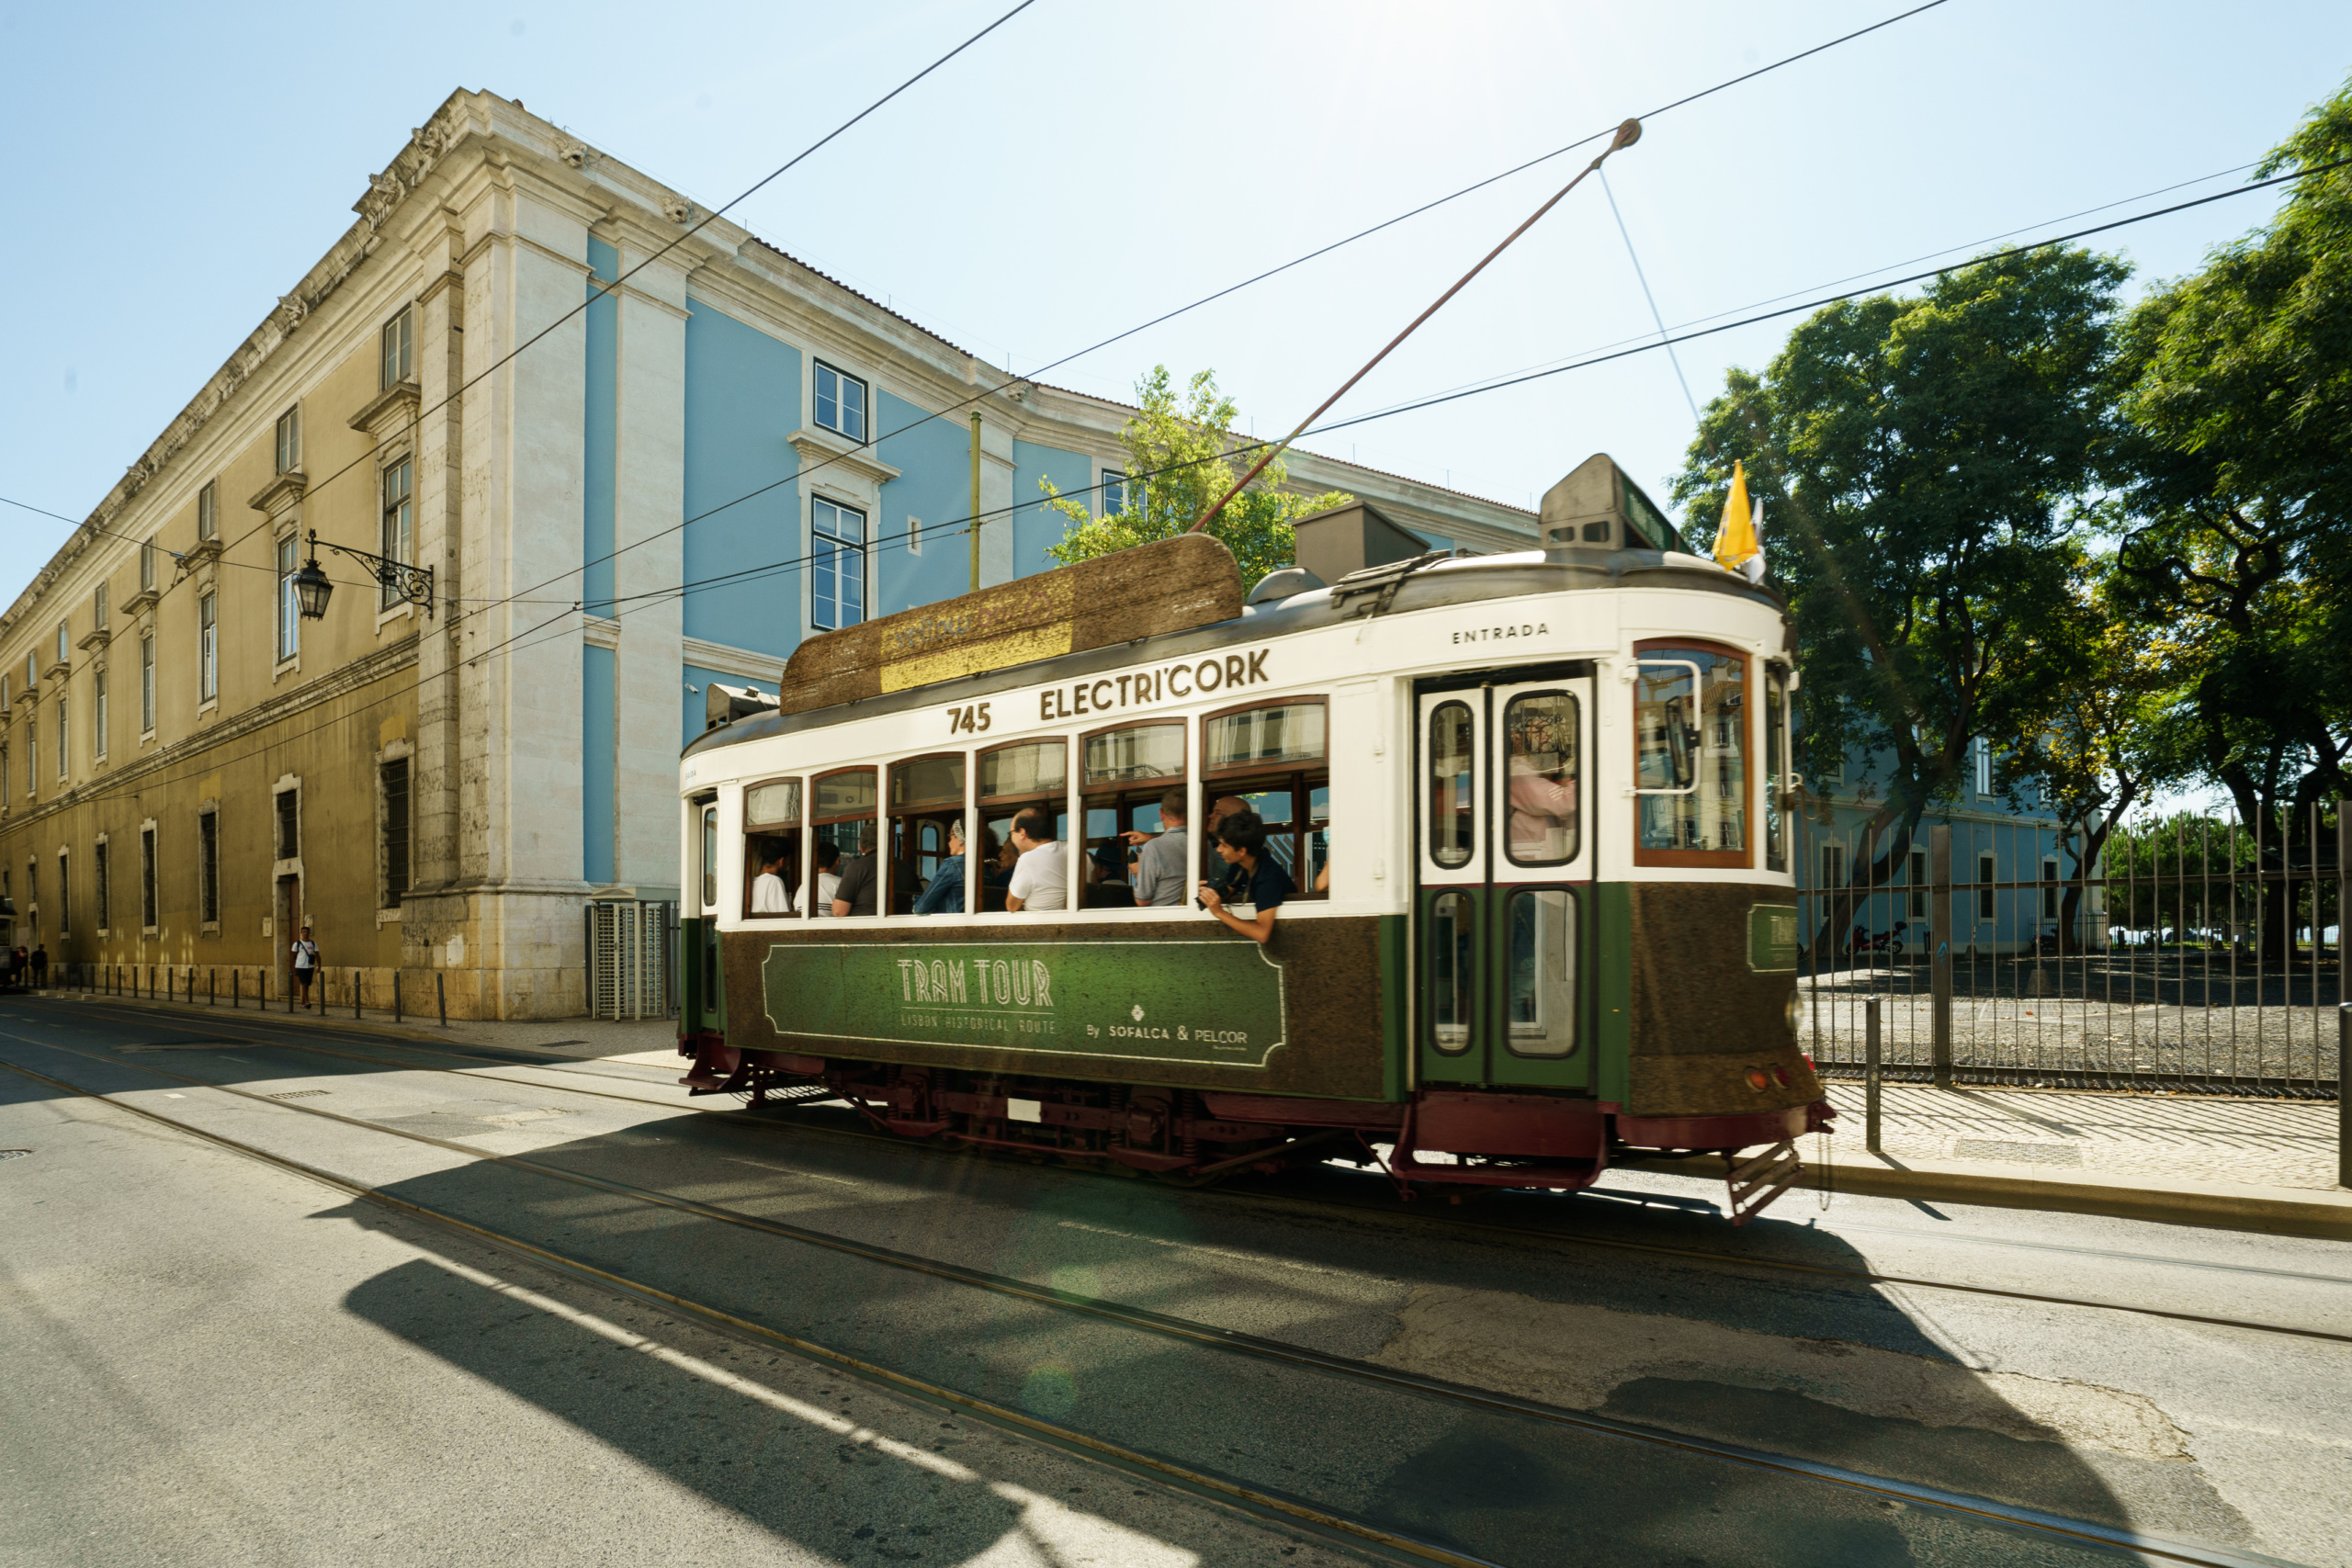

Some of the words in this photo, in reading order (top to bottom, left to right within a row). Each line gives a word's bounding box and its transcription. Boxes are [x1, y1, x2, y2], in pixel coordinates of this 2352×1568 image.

[895, 612, 972, 647] yellow
[1453, 623, 1549, 644] ENTRADA
[946, 702, 990, 734] 745
[1040, 649, 1270, 721] ELECTRI'CORK
[897, 959, 967, 1003] TRAM
[973, 959, 1054, 1006] TOUR
[901, 1013, 938, 1027] LISBON
[945, 1016, 1010, 1032] HISTORICAL
[1019, 1020, 1056, 1034] ROUTE
[1086, 1024, 1100, 1039] By
[1109, 1025, 1170, 1040] SOFALCA
[1177, 1025, 1189, 1041] &
[1194, 1030, 1248, 1043] PELCOR
